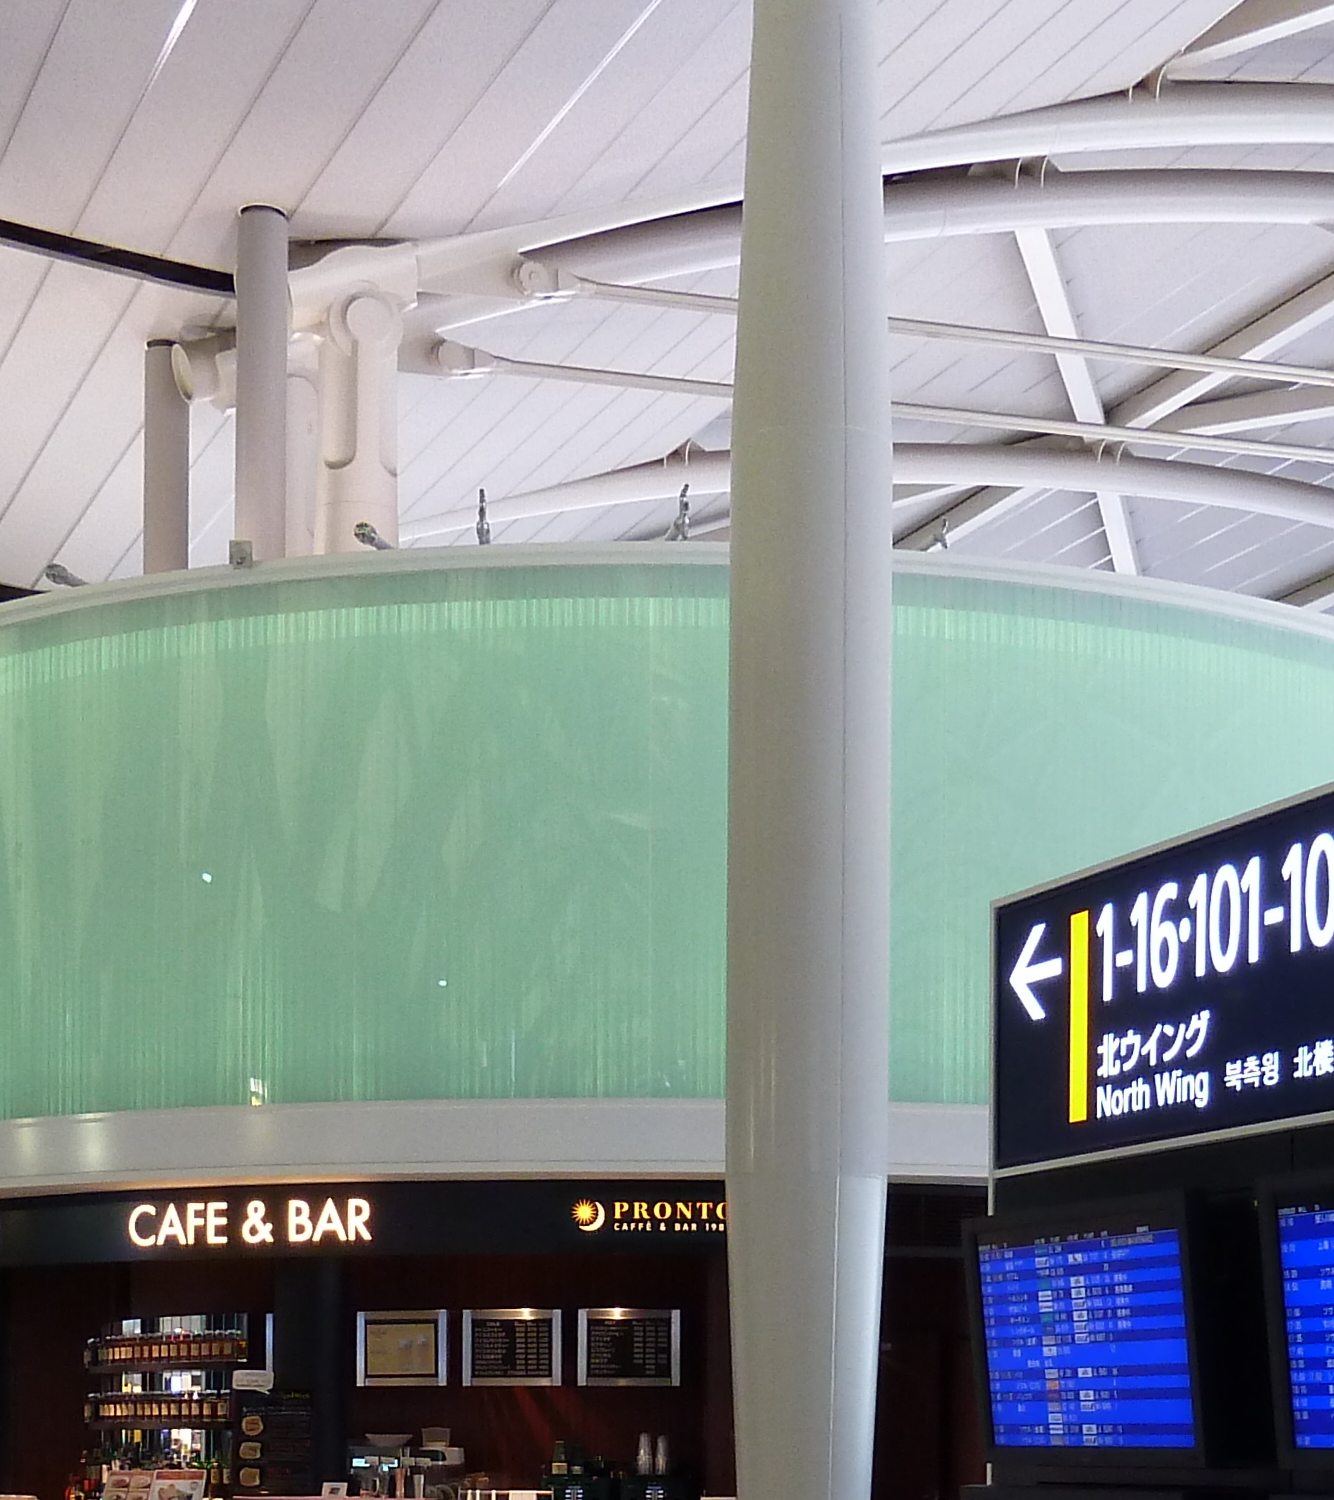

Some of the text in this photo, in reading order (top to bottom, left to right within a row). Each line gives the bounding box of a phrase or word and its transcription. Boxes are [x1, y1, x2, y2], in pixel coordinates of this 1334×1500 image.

[1097, 1010, 1210, 1078] 北ウイング
[1097, 1068, 1210, 1119] North Wing
[1224, 1051, 1280, 1092] 북측윙
[129, 1198, 372, 1248] CAFE & BAR
[659, 1223, 666, 1231] &
[674, 1222, 698, 1231] BAR
[705, 1222, 724, 1231] 198
